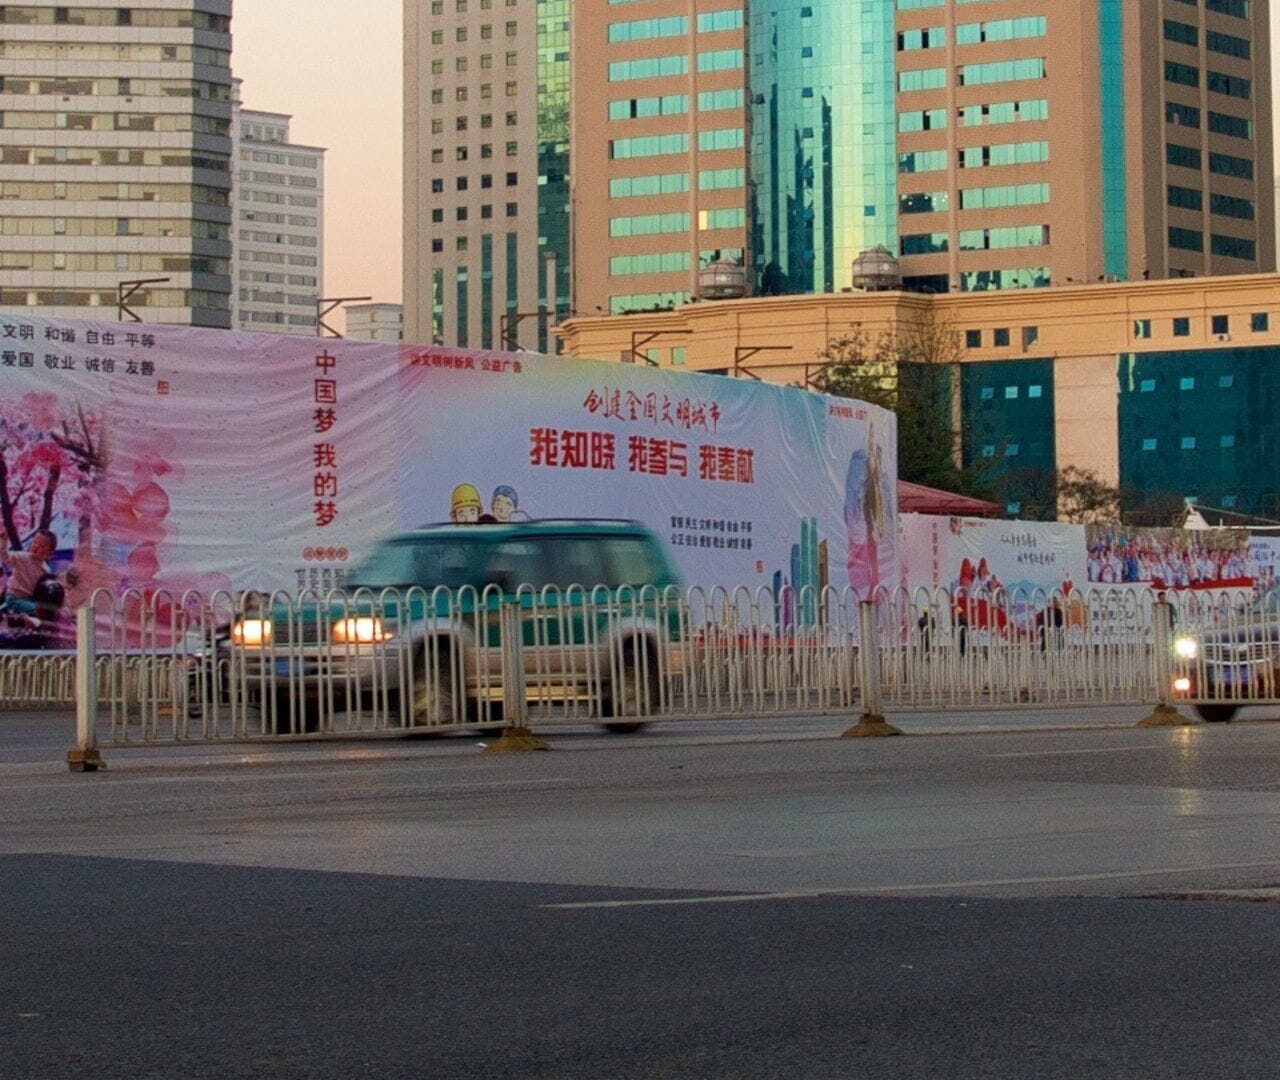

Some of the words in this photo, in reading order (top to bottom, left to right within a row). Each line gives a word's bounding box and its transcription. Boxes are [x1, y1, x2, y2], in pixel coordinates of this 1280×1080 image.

[3, 323, 35, 340] 文明
[44, 326, 76, 343] 和谐
[86, 330, 115, 346] 自由
[125, 333, 156, 348] 平等
[2, 350, 34, 367] 爱国
[44, 353, 76, 370] 敬业
[85, 357, 115, 373] 诚信
[125, 359, 156, 376] 友善
[410, 353, 475, 369] 讲文明树新风
[481, 359, 523, 373] 公益广告
[313, 349, 338, 433] 中国梦
[583, 386, 721, 433] 创建全国文明城市
[530, 428, 615, 470] 我知晓
[699, 444, 754, 484] 我奉献
[313, 443, 338, 526] 我的梦
